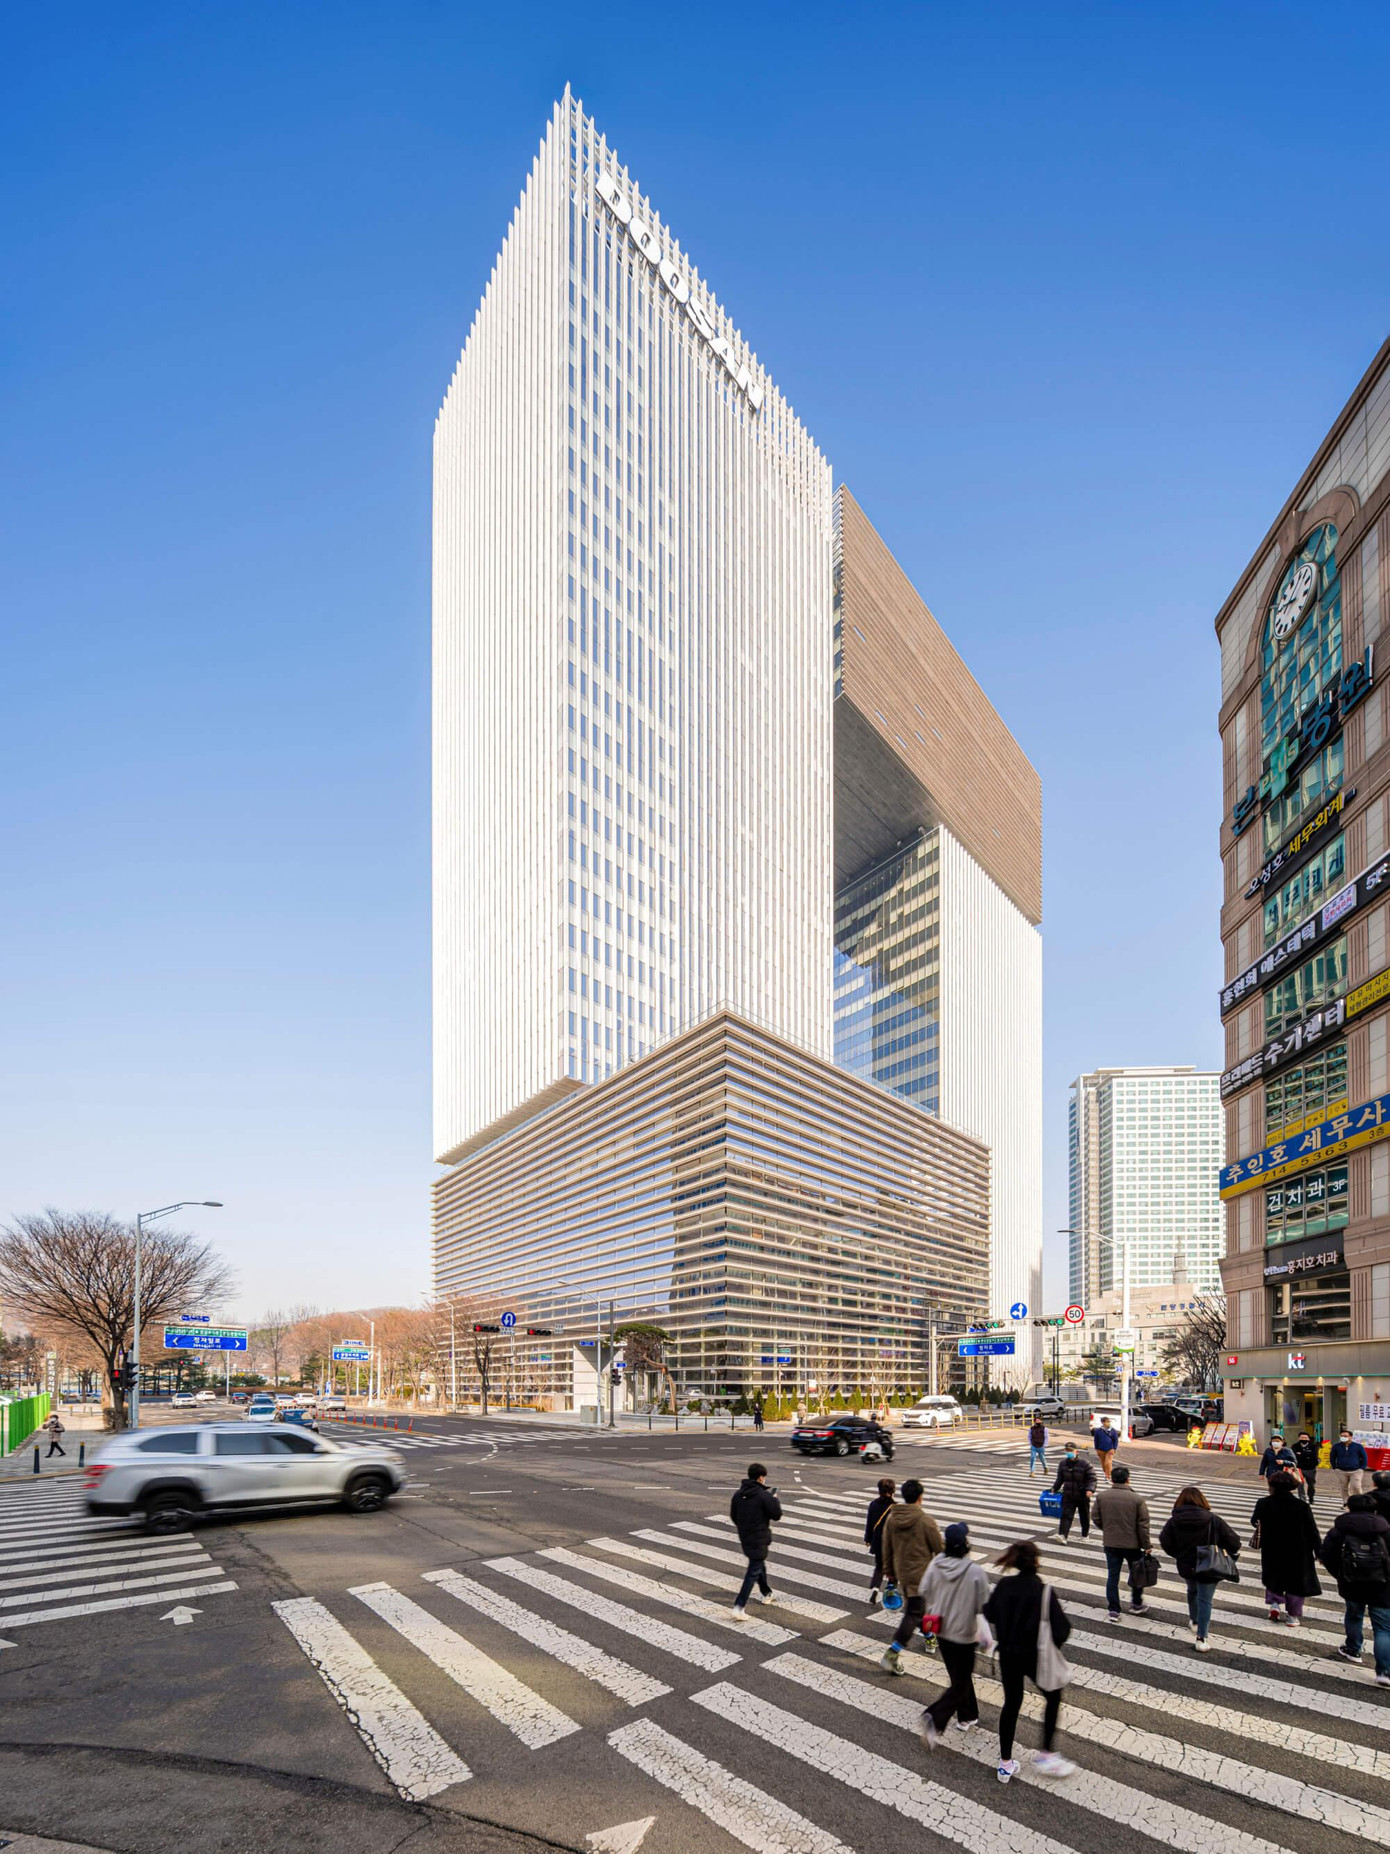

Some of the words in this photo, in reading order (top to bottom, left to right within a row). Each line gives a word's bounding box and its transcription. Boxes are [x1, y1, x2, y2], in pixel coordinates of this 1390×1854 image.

[595, 170, 764, 409] DOOSAN
[1232, 786, 1256, 837] 본
[1302, 644, 1374, 748] 병원
[1246, 852, 1285, 896] 오성호
[1287, 792, 1345, 856] 세무회계
[1366, 862, 1388, 890] 5F
[1264, 998, 1345, 1065] 수기센터
[1226, 1144, 1289, 1184] 추인호
[1298, 1100, 1387, 1152] 세무사
[1261, 1141, 1348, 1182] 714-5363
[1369, 1127, 1386, 1140] 3층
[1332, 1179, 1346, 1192] 3F
[1287, 1250, 1338, 1275] 홍지호치과
[1069, 1309, 1081, 1319] 50
[1288, 1352, 1306, 1370] kt
